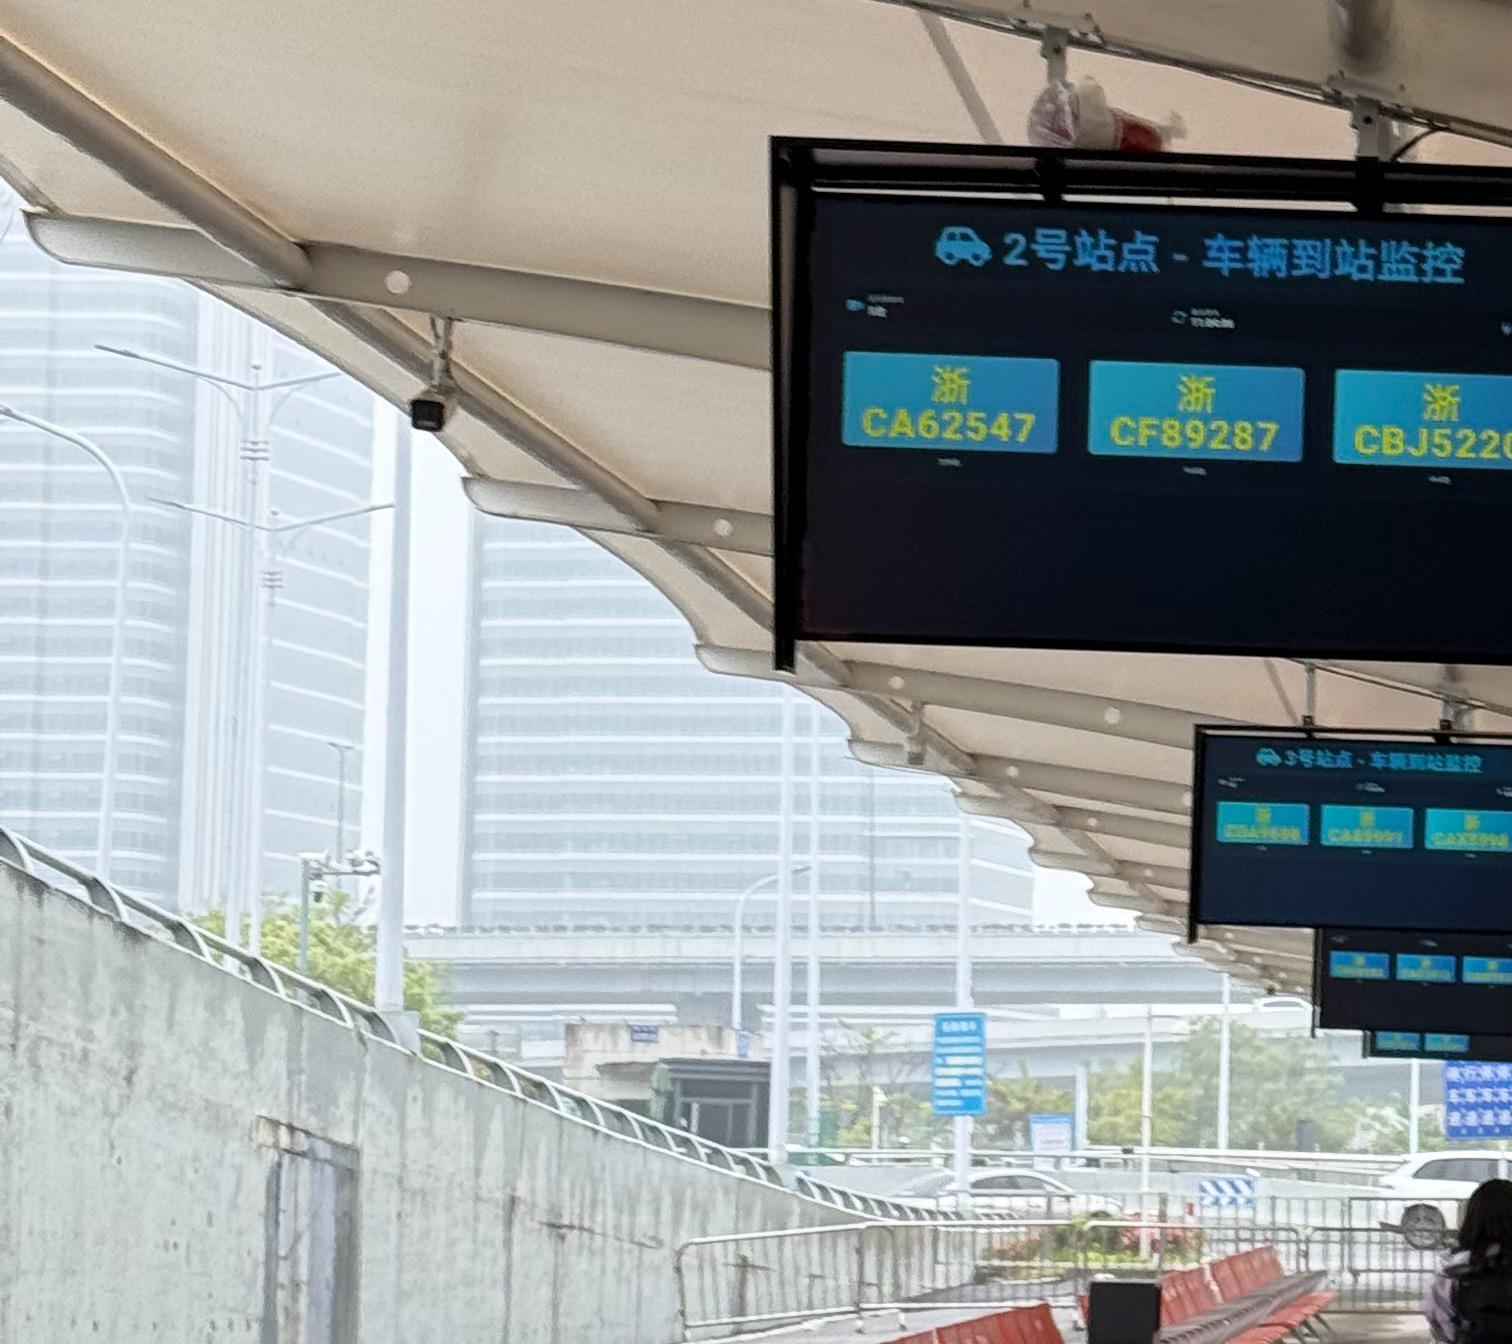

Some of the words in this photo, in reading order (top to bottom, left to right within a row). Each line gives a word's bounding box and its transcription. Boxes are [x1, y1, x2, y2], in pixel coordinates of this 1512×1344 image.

[1002, 227, 1161, 273] 2号站点
[1202, 232, 1467, 284] 车辆到站监控
[931, 364, 972, 405] 浙
[1177, 374, 1217, 414] 浙
[1422, 383, 1461, 423] 浙
[861, 405, 1037, 444] CA62547
[1109, 416, 1281, 453] CF89287
